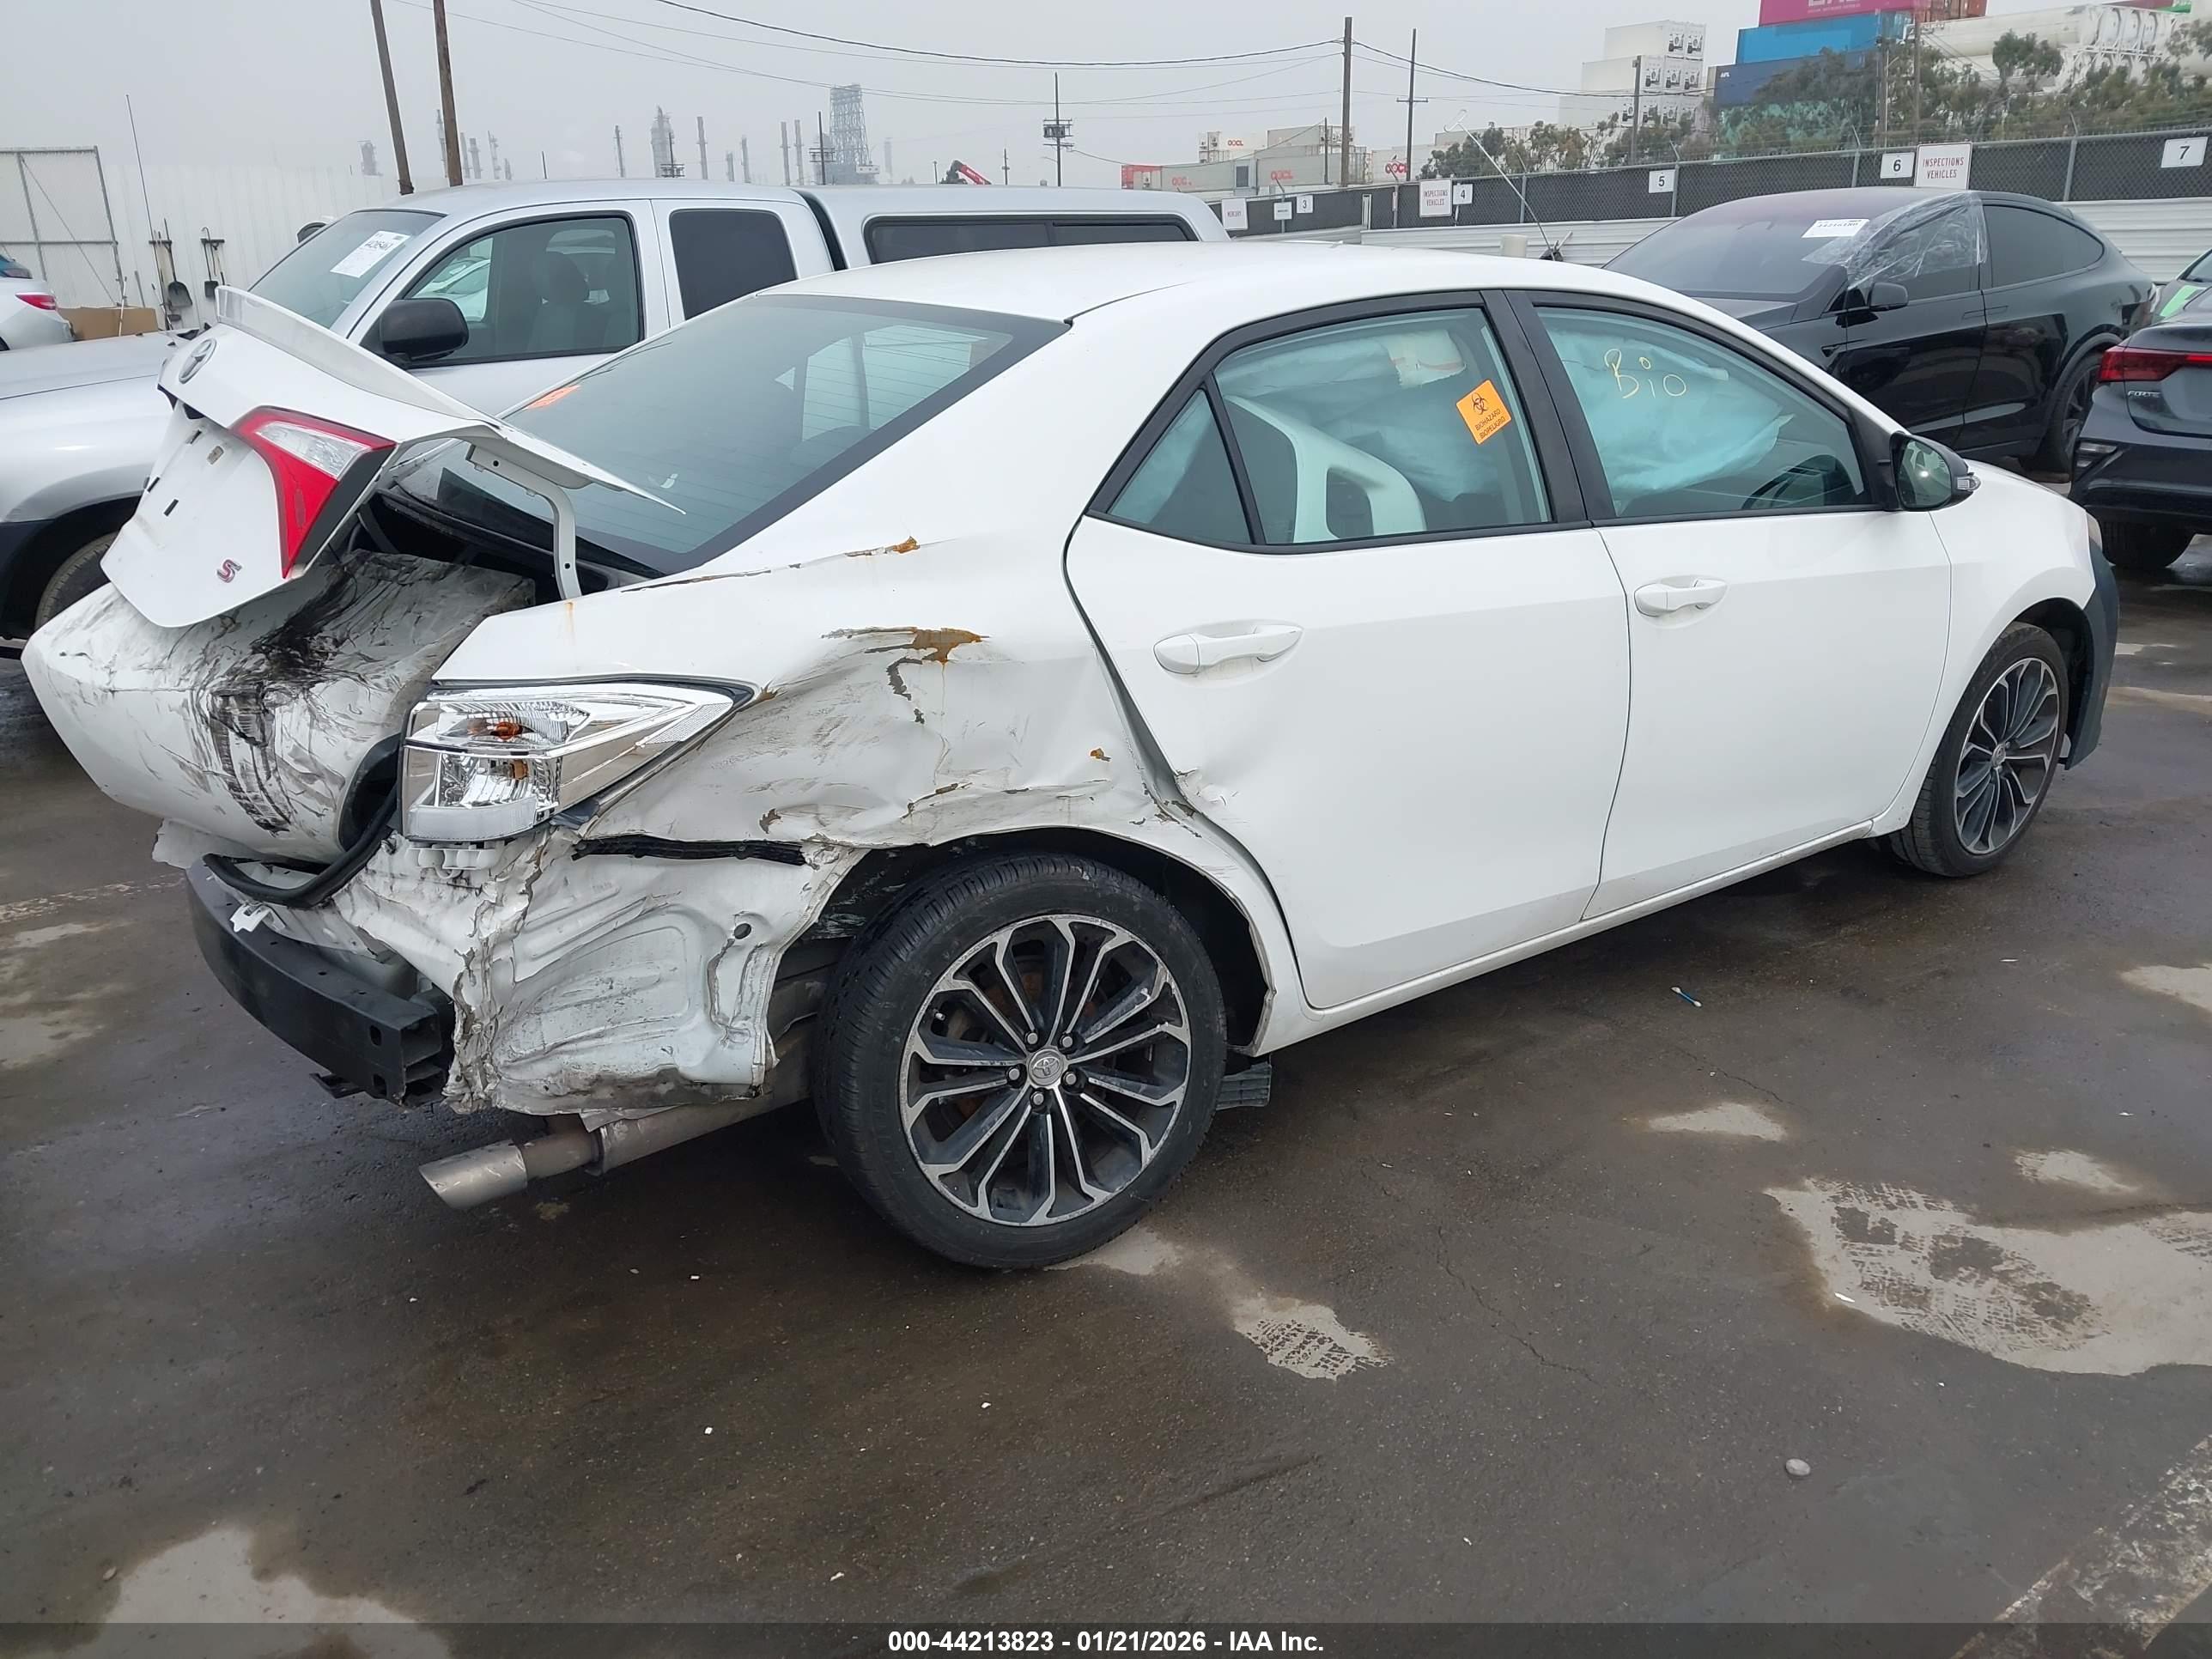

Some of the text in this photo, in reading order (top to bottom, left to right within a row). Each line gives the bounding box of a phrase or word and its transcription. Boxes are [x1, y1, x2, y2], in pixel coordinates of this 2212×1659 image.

[2179, 145, 2191, 160] 7
[1893, 159, 1902, 172] 6
[1923, 156, 1965, 167] INSPECTIONS
[1927, 169, 1958, 179] VEHICLES
[1658, 175, 1665, 187] 5
[1423, 189, 1449, 198] INSPECTIONS
[1460, 189, 1466, 199] 4
[1303, 199, 1307, 210] 3
[1426, 198, 1445, 207] VEHICLES
[1474, 408, 1502, 431] BIOHAZARD
[1479, 416, 1506, 439] BIOPELIGRO
[216, 559, 242, 583] S
